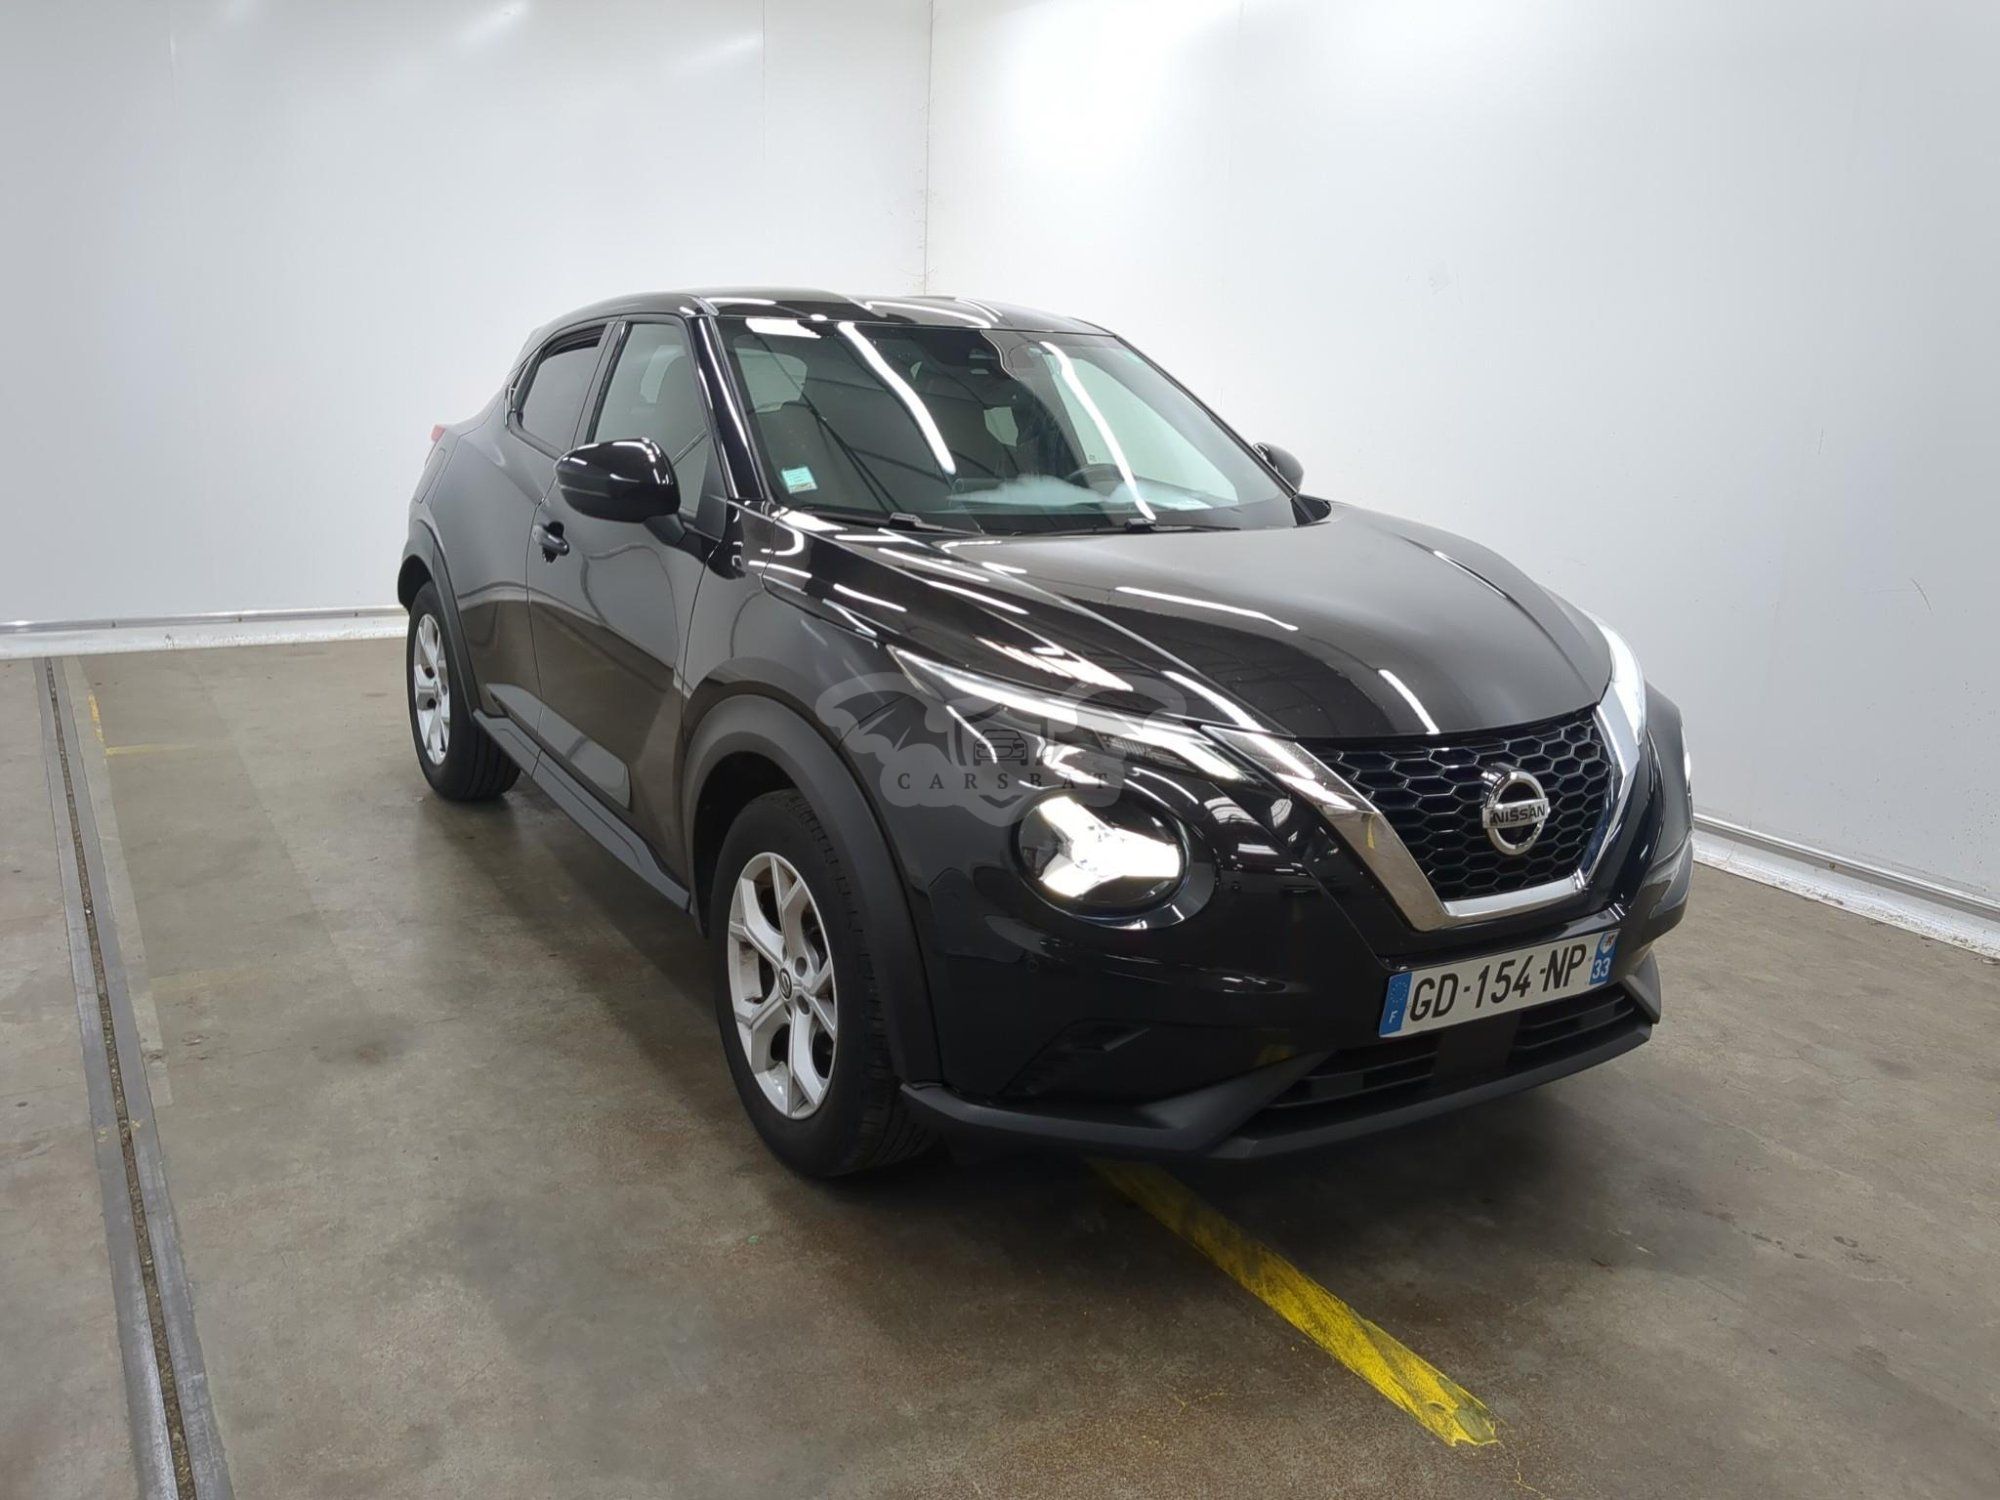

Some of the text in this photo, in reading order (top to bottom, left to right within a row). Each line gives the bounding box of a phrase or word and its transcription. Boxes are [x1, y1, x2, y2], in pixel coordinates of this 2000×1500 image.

[1492, 804, 1546, 824] NISSAN
[1592, 957, 1611, 980] 33
[1410, 944, 1587, 1022] GD-154-NP
[1388, 1010, 1398, 1024] F
